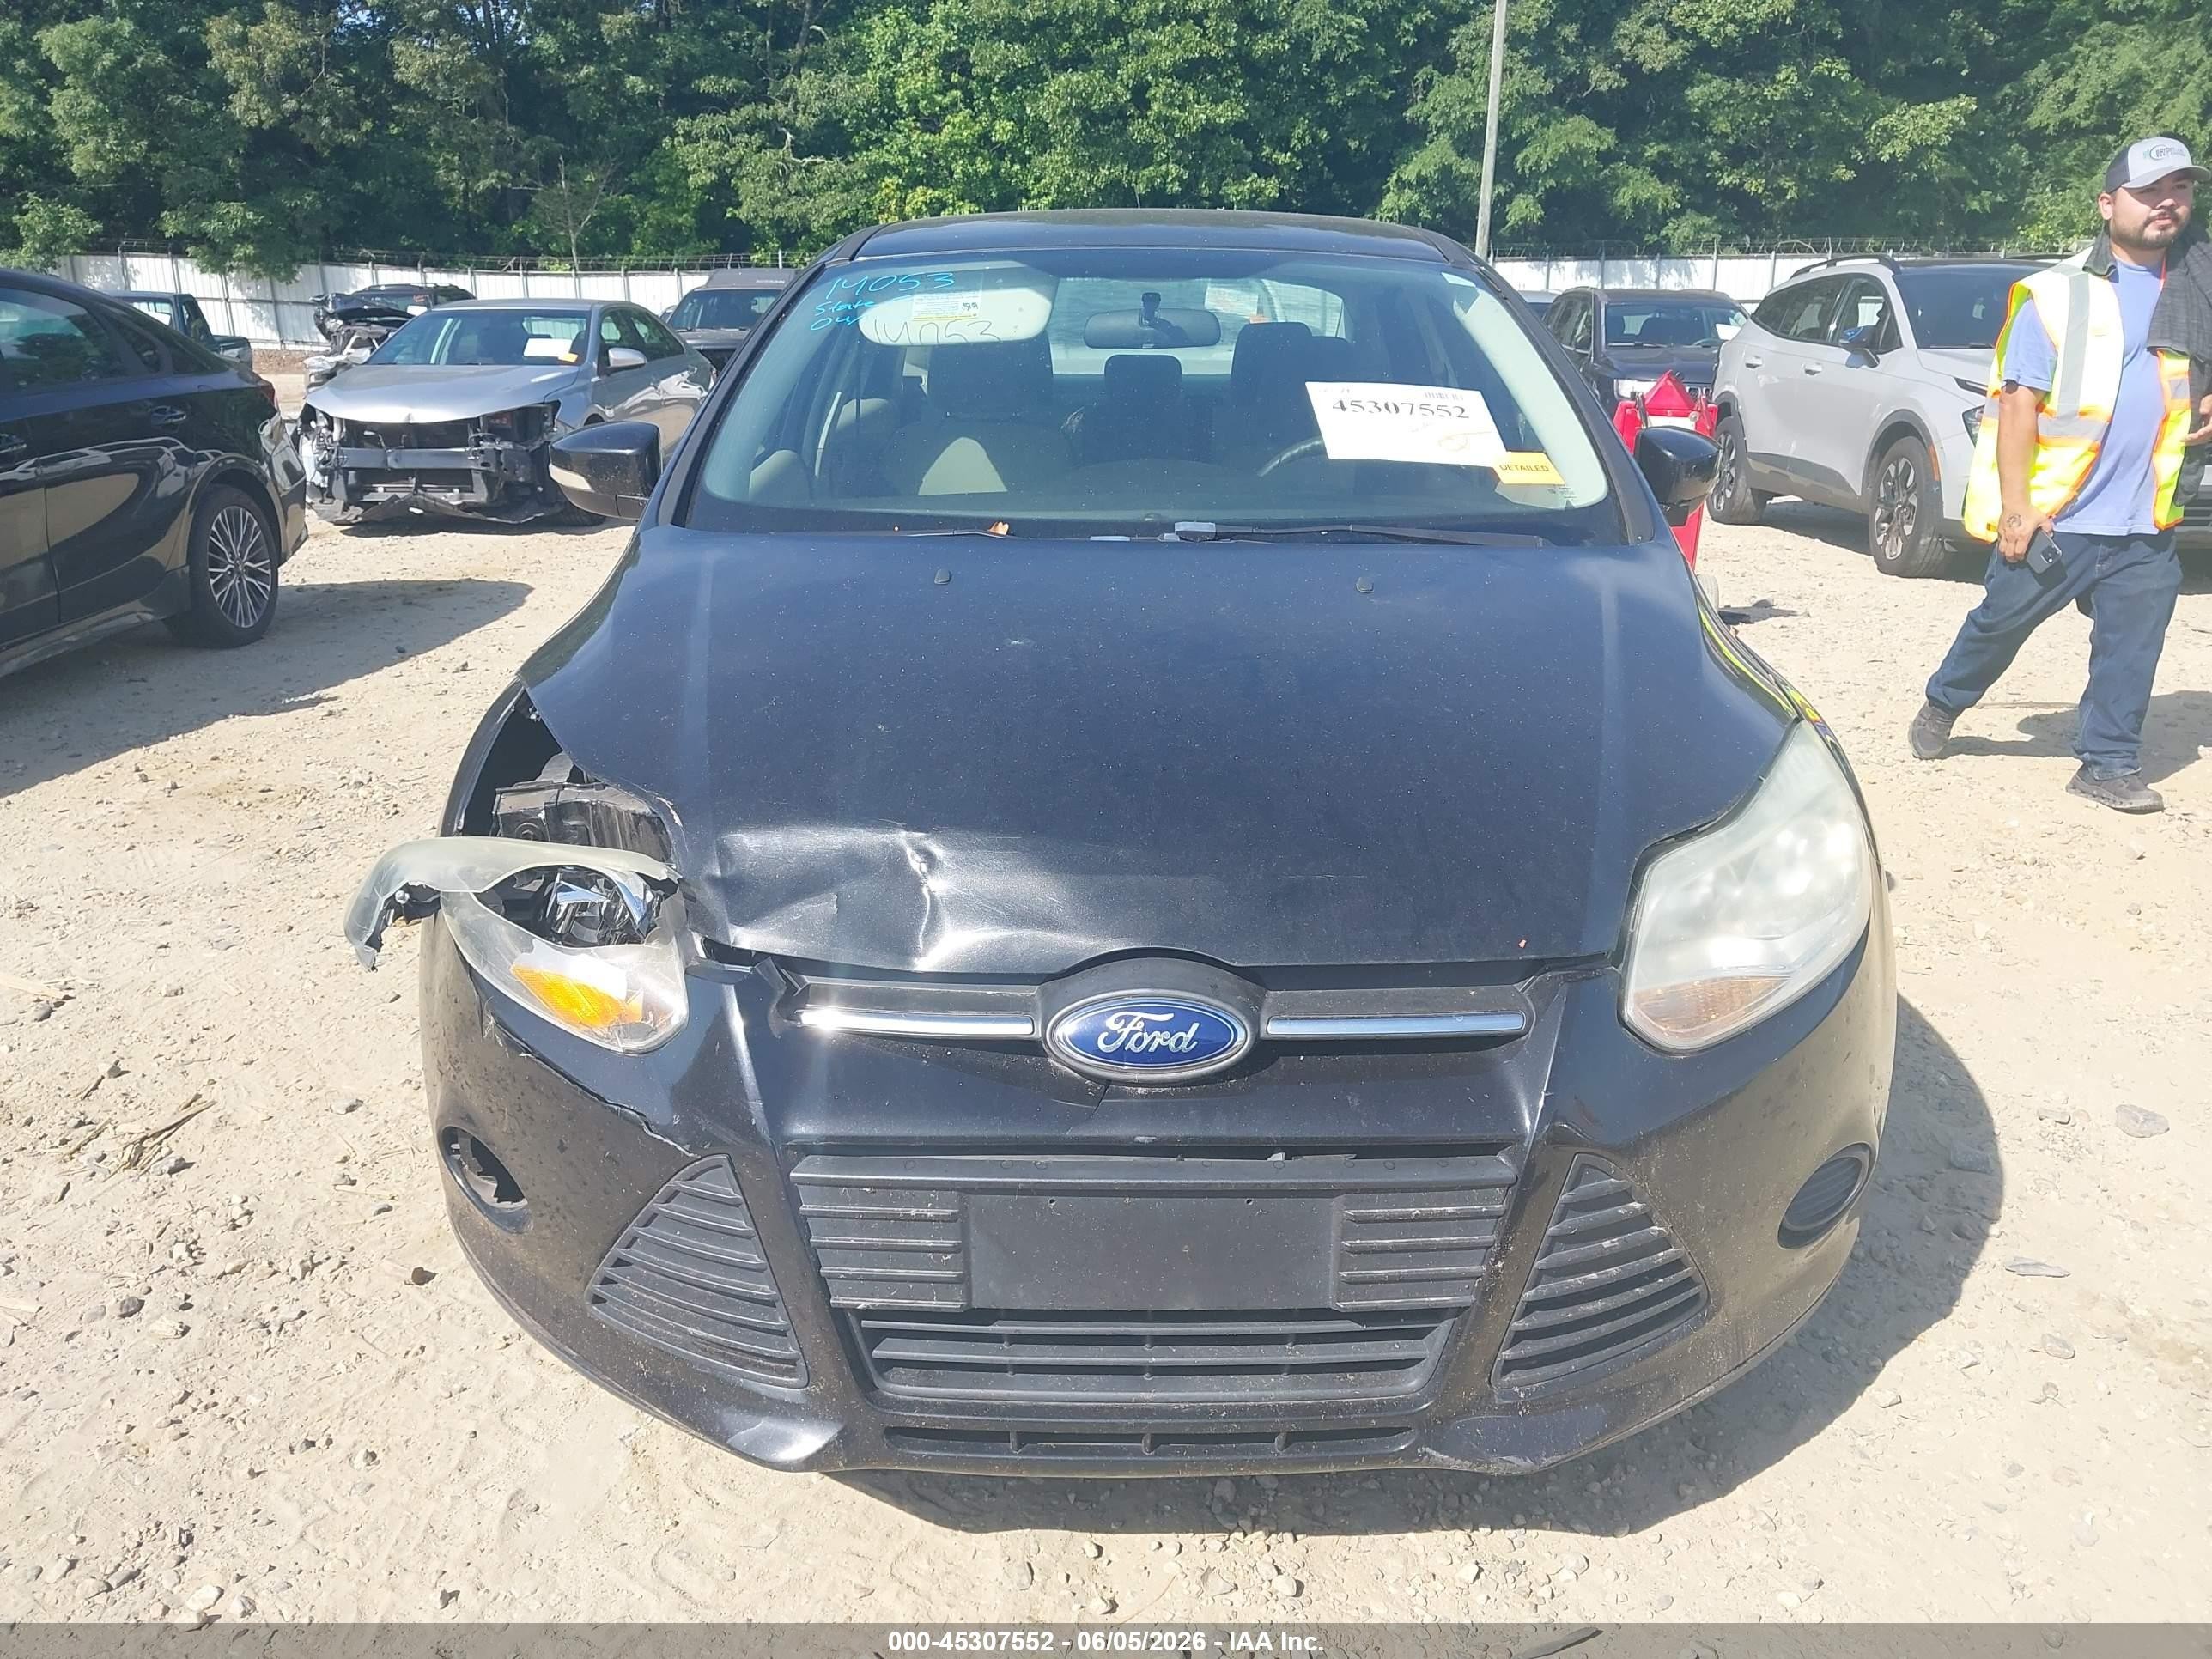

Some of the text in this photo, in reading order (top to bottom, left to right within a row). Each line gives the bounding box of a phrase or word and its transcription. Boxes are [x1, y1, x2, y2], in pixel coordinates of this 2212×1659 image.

[825, 273, 956, 300] 14053
[1333, 399, 1470, 419] 45307552
[1097, 1011, 1200, 1053] Ford
